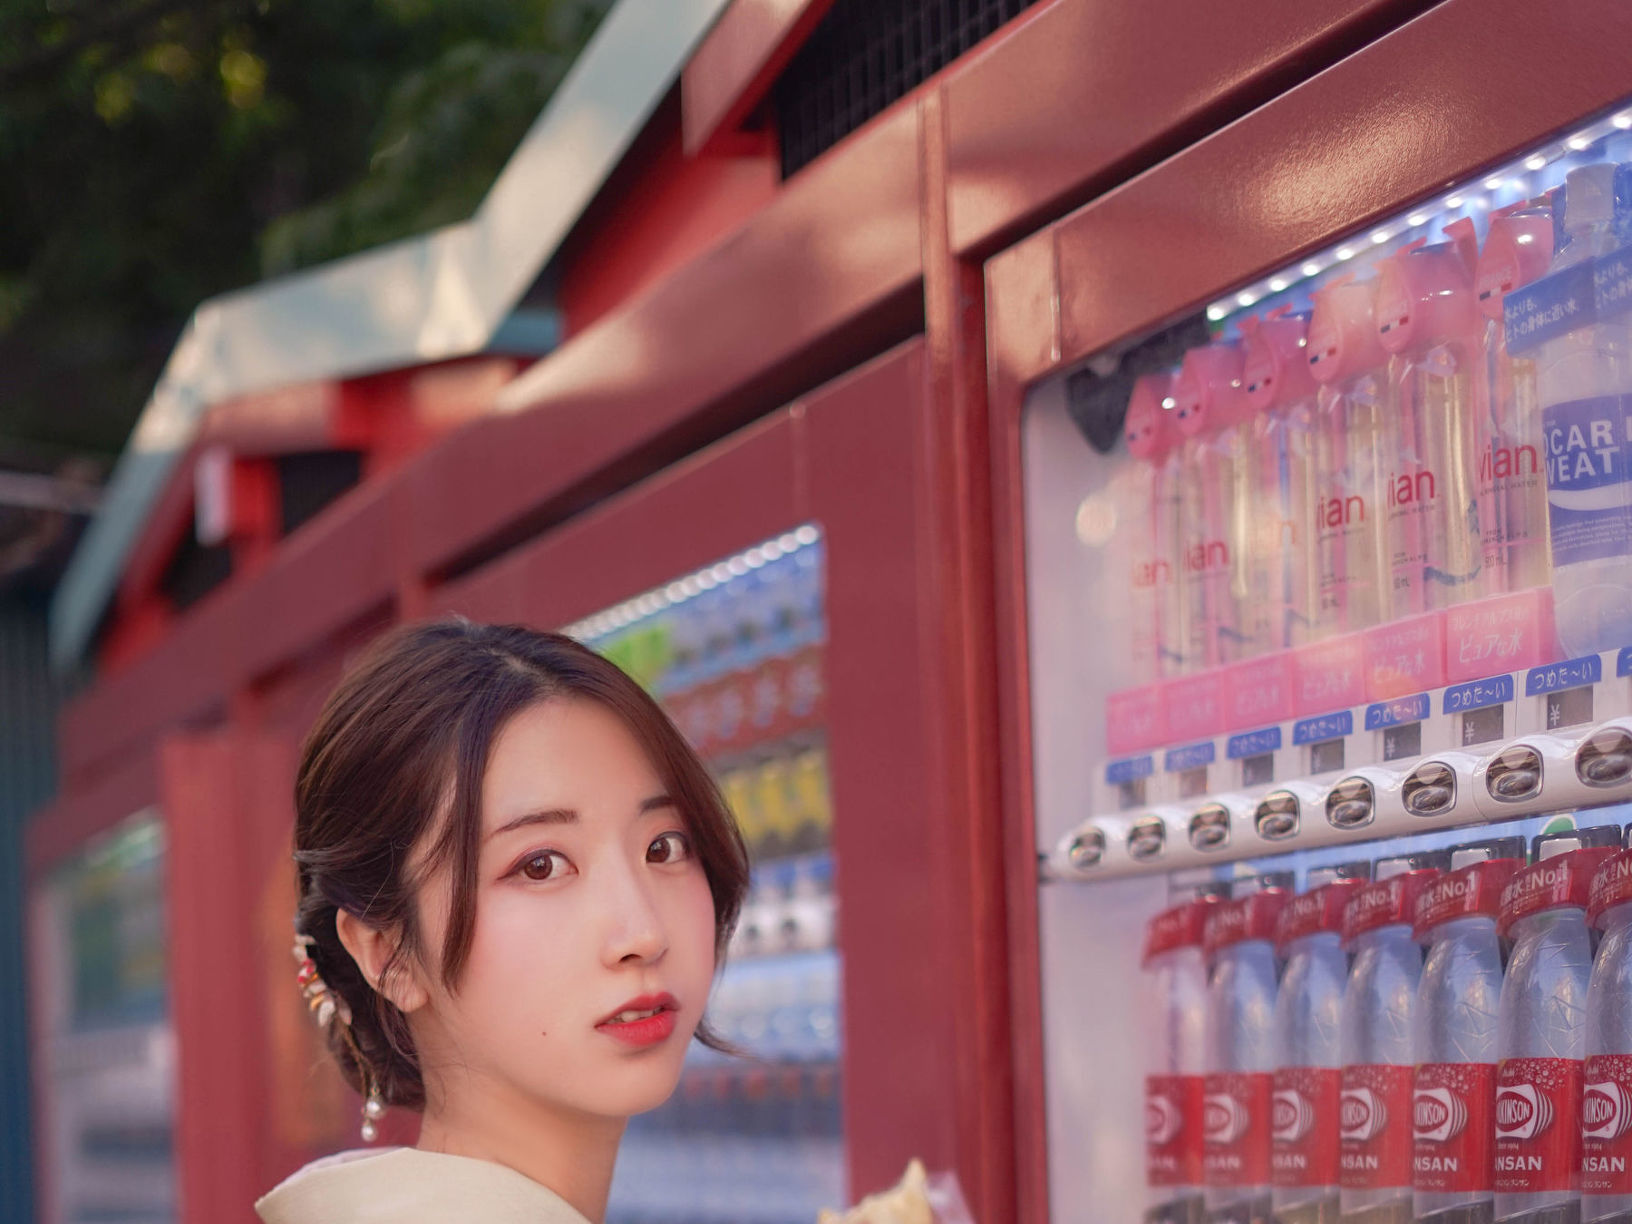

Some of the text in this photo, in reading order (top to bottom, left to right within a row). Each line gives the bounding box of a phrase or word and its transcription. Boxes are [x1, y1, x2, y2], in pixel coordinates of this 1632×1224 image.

[1545, 416, 1632, 459] CARI
[1532, 860, 1569, 888] No.1
[1498, 1098, 1531, 1124] KINSON
[1495, 1156, 1542, 1171] NSAN
